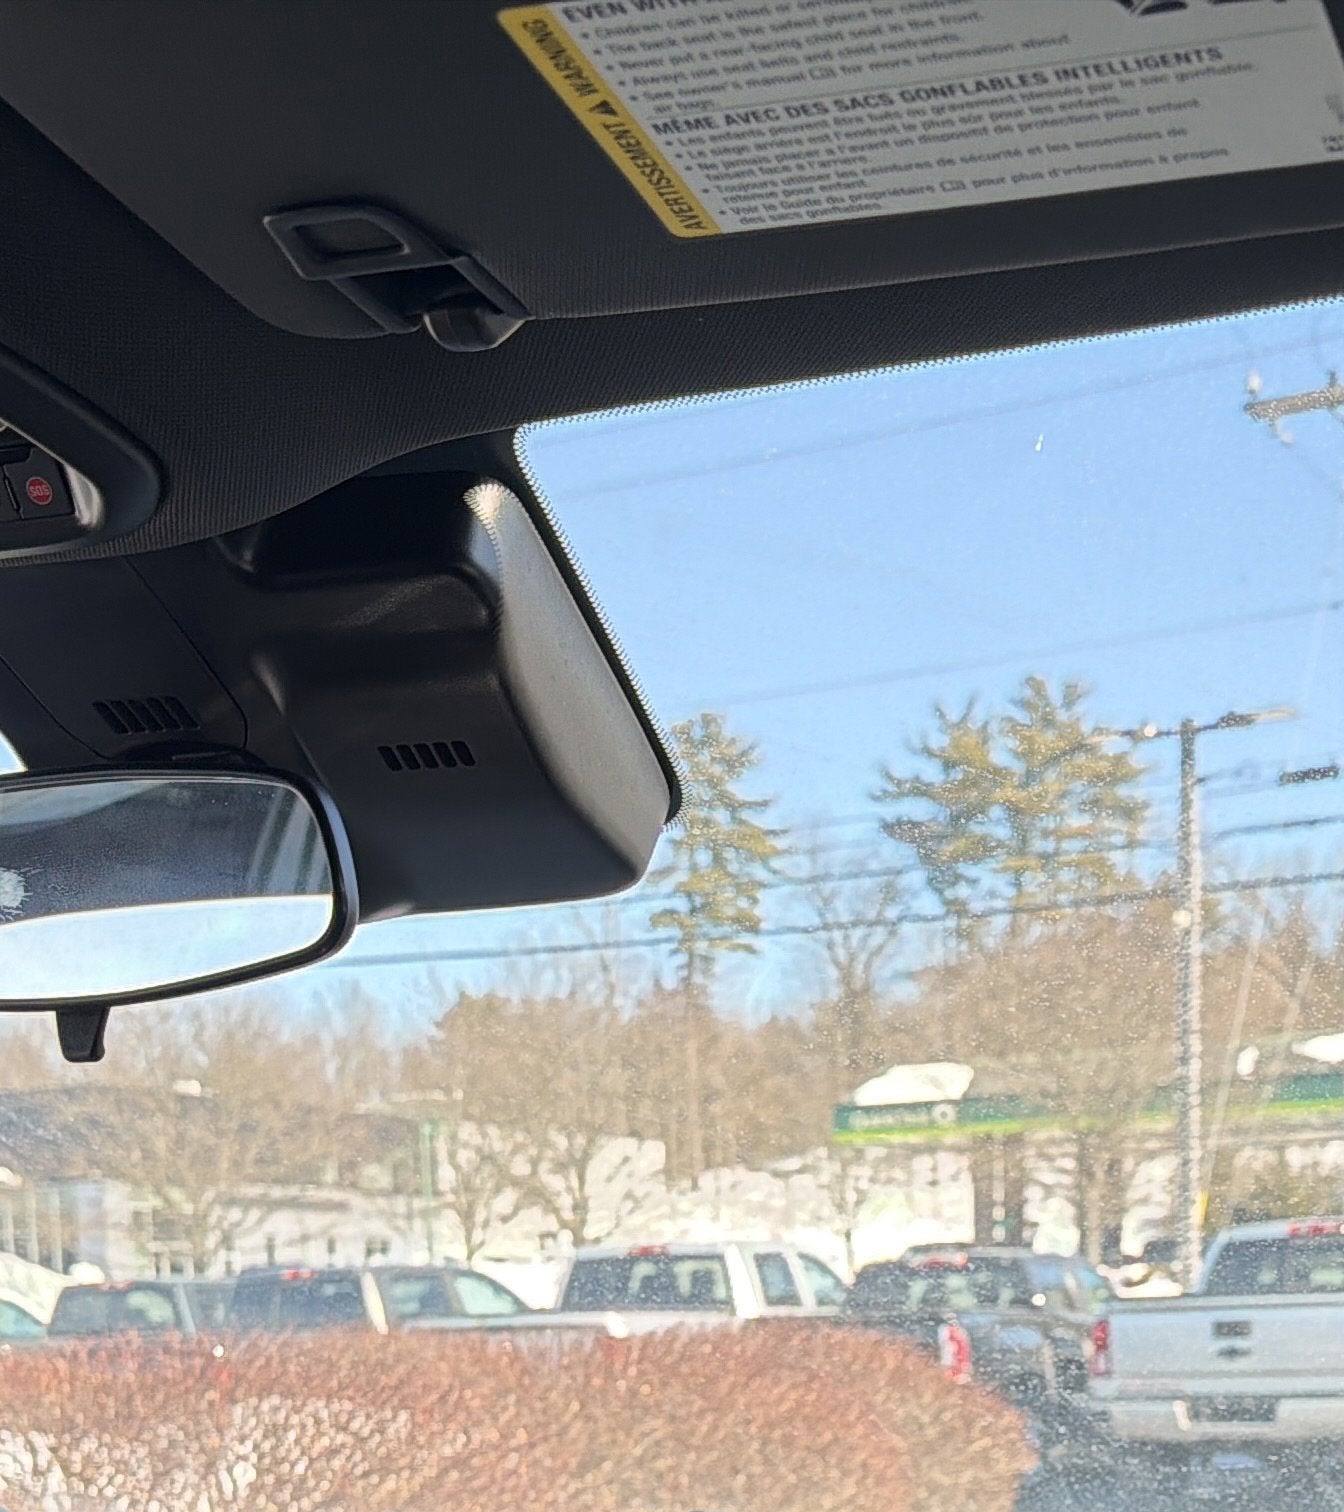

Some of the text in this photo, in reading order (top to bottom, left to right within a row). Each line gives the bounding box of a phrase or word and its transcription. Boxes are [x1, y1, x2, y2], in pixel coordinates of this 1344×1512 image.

[561, 0, 627, 23] EVEN
[522, 18, 598, 97] WARNING
[723, 107, 780, 126] AVEC
[782, 100, 829, 119] DES
[832, 91, 895, 112] SACS
[899, 70, 1048, 103] GONFLABLES
[1053, 45, 1222, 81] INTELLIGENTS
[602, 121, 709, 231] AVERTISSEMENT
[30, 486, 49, 497] SOS
